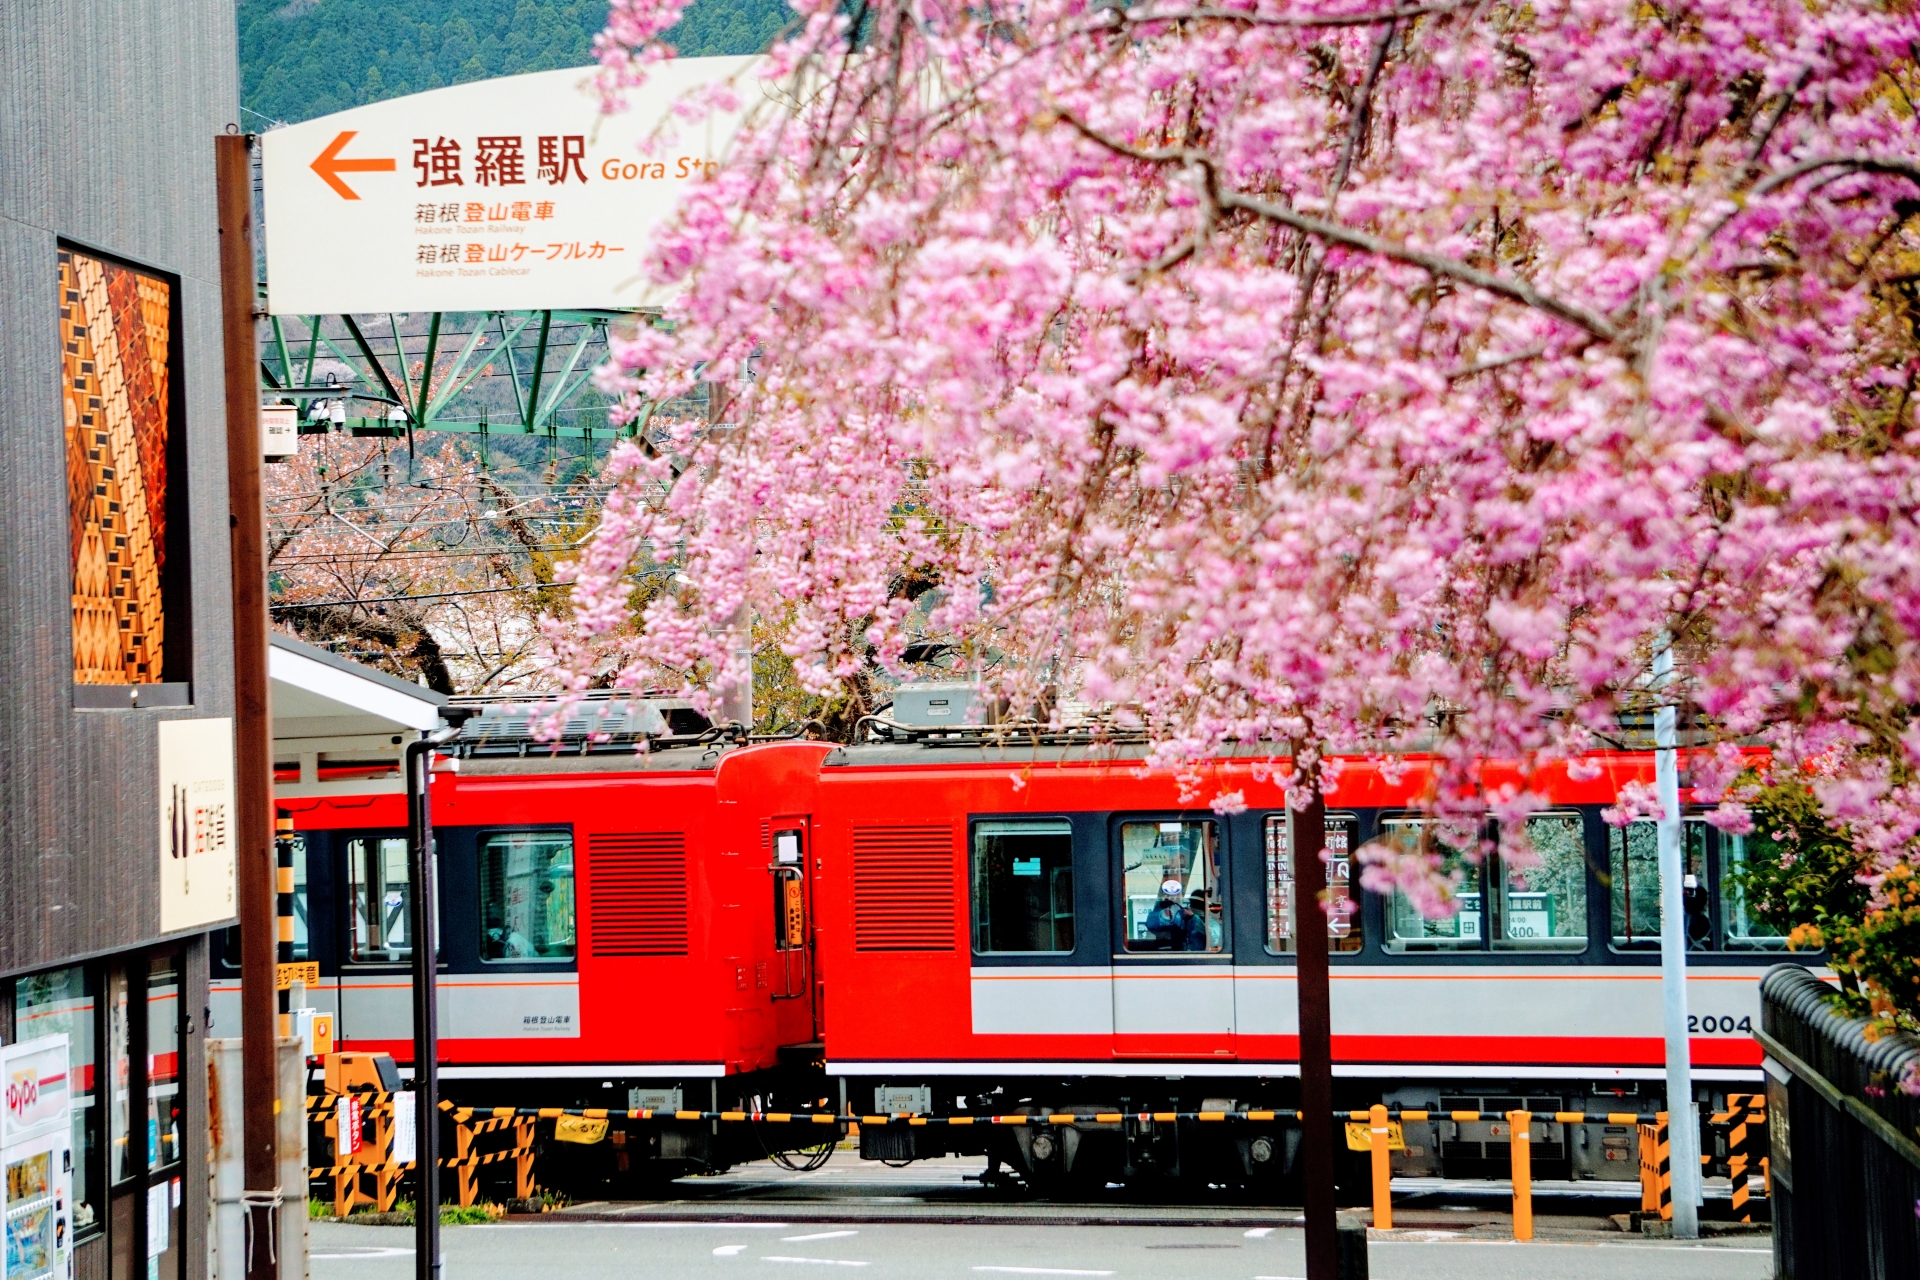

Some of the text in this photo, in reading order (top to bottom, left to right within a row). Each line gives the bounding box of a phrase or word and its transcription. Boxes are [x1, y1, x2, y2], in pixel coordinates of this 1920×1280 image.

[412, 135, 589, 187] 強羅駅
[601, 158, 665, 180] Gora
[415, 201, 555, 223] 箱根登山電車
[415, 224, 525, 235] Hakone Tozan Railway
[416, 240, 625, 264] 箱根登山ケーブルカー
[416, 266, 530, 278] Hakone Tozan Cablecar
[523, 1015, 571, 1025] 箱根登山電車
[1687, 1014, 1751, 1034] 2004
[10, 1080, 37, 1116] DyDo
